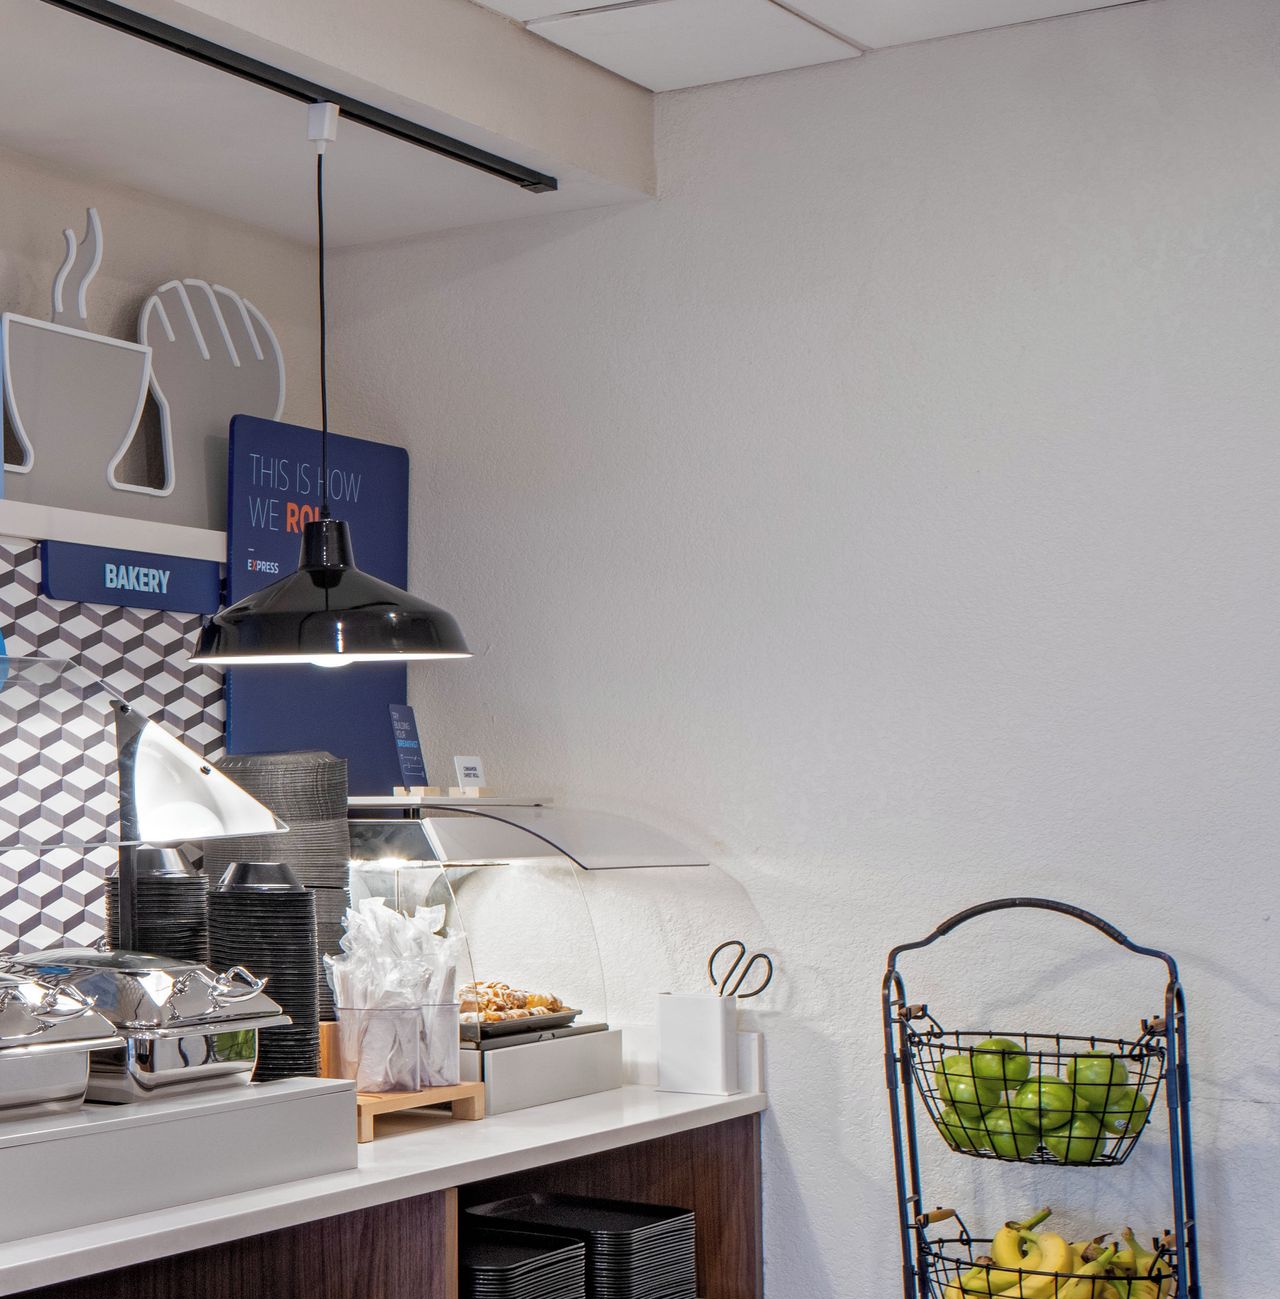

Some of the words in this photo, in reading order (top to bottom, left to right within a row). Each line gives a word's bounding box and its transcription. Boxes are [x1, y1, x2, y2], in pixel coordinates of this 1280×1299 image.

[248, 453, 290, 491] THIS
[296, 463, 311, 495] IS
[317, 467, 361, 503] HOW
[248, 495, 280, 531] WE
[286, 502, 320, 534] RO
[104, 563, 171, 594] BAKERY
[247, 559, 279, 574] EXPRESS
